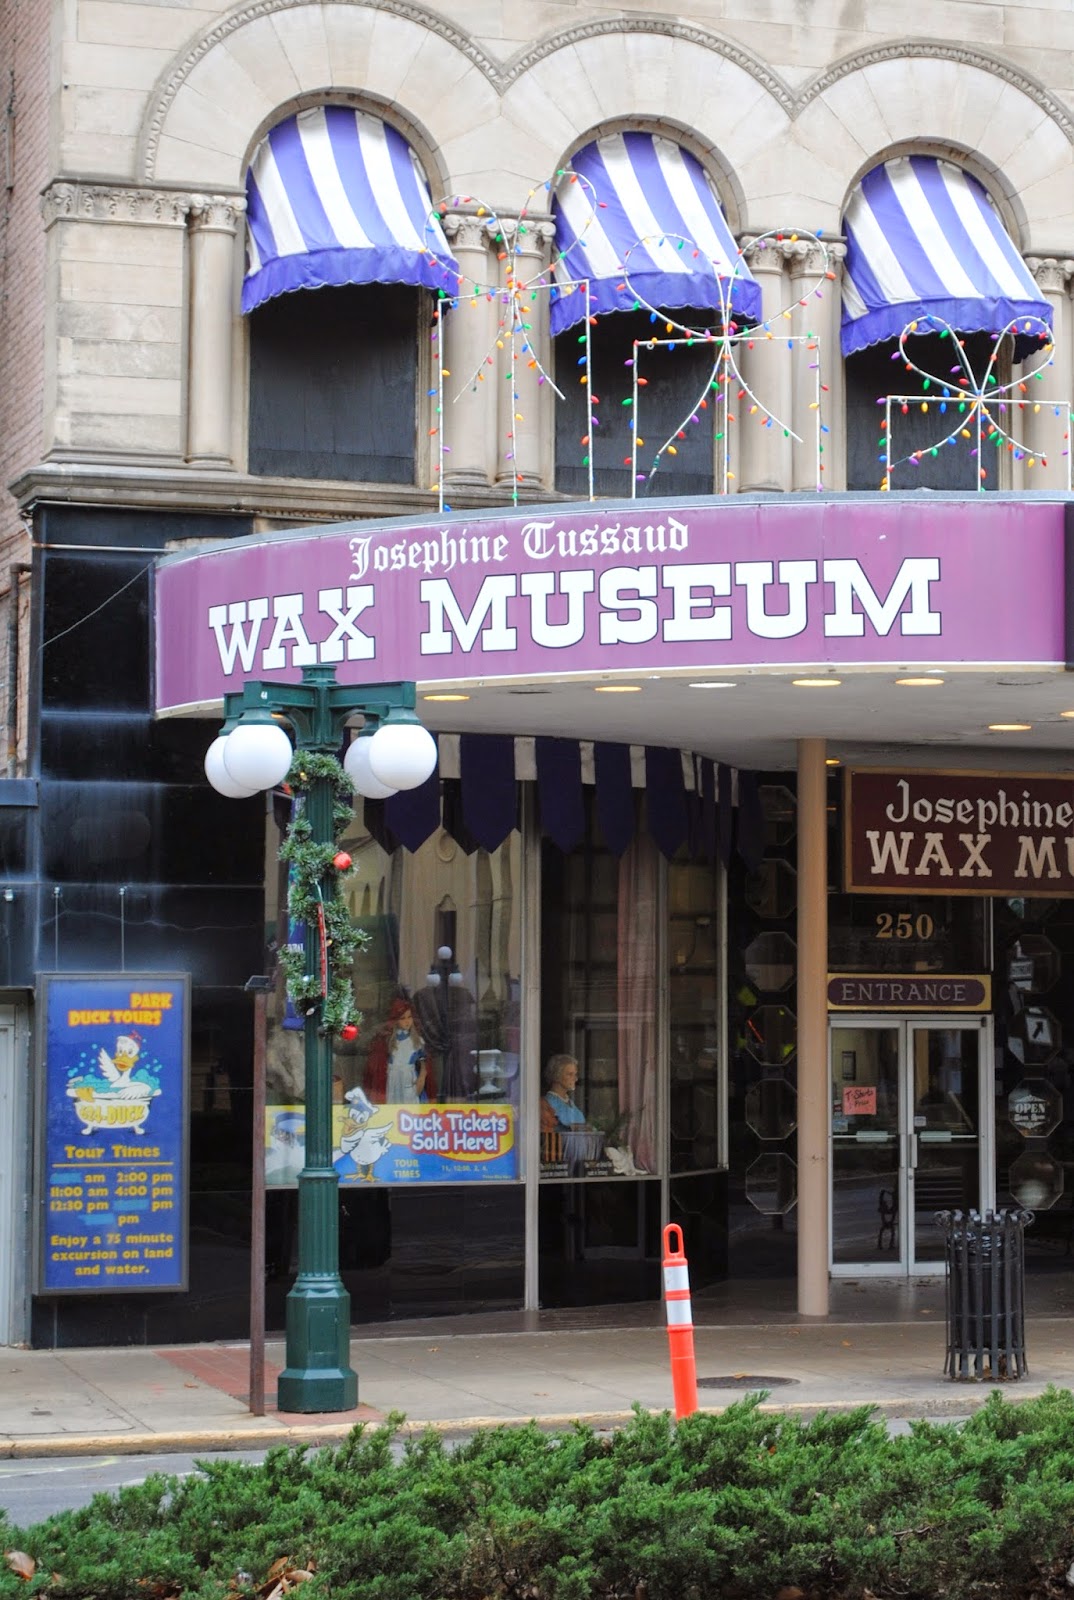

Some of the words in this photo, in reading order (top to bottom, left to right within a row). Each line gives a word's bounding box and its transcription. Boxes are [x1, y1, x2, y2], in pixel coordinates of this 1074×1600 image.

[349, 529, 509, 580] Josephine
[520, 516, 691, 561] Tussaud
[208, 583, 377, 676] WAX
[420, 557, 942, 655] MUSEUM
[886, 778, 1074, 834] Josephine
[866, 830, 993, 878] WAX
[1013, 836, 1074, 879] M
[875, 913, 934, 940] 250
[841, 982, 967, 1003] ENTRANCE
[130, 992, 173, 1009] PARK
[67, 1010, 111, 1027] DUCK
[112, 1009, 163, 1026] TOURS
[1015, 1103, 1046, 1113] OPEN
[400, 1112, 443, 1132] Duck
[447, 1110, 507, 1132] Tickets
[411, 1131, 450, 1151] Sold
[453, 1130, 499, 1151] Here!
[64, 1145, 106, 1159] Tour
[111, 1143, 161, 1158] Times
[394, 1158, 419, 1168] TOUR
[84, 1174, 107, 1183] am
[116, 1171, 149, 1183] 2:00
[151, 1172, 174, 1184] pm
[393, 1170, 421, 1179] TIMES
[87, 1188, 109, 1197] am
[114, 1185, 148, 1196] 4:00
[151, 1186, 174, 1199] pm
[50, 1200, 84, 1212] 12:30
[86, 1201, 110, 1214] pm
[151, 1200, 174, 1212] pm
[117, 1214, 140, 1226] pm
[51, 1235, 89, 1248] Enjoy
[92, 1237, 101, 1245] a
[107, 1233, 122, 1245] 75
[125, 1233, 174, 1244] minute
[51, 1250, 118, 1261] excursion
[121, 1251, 140, 1259] on
[143, 1248, 174, 1259] land
[74, 1265, 101, 1276] and
[105, 1265, 150, 1275] water.
